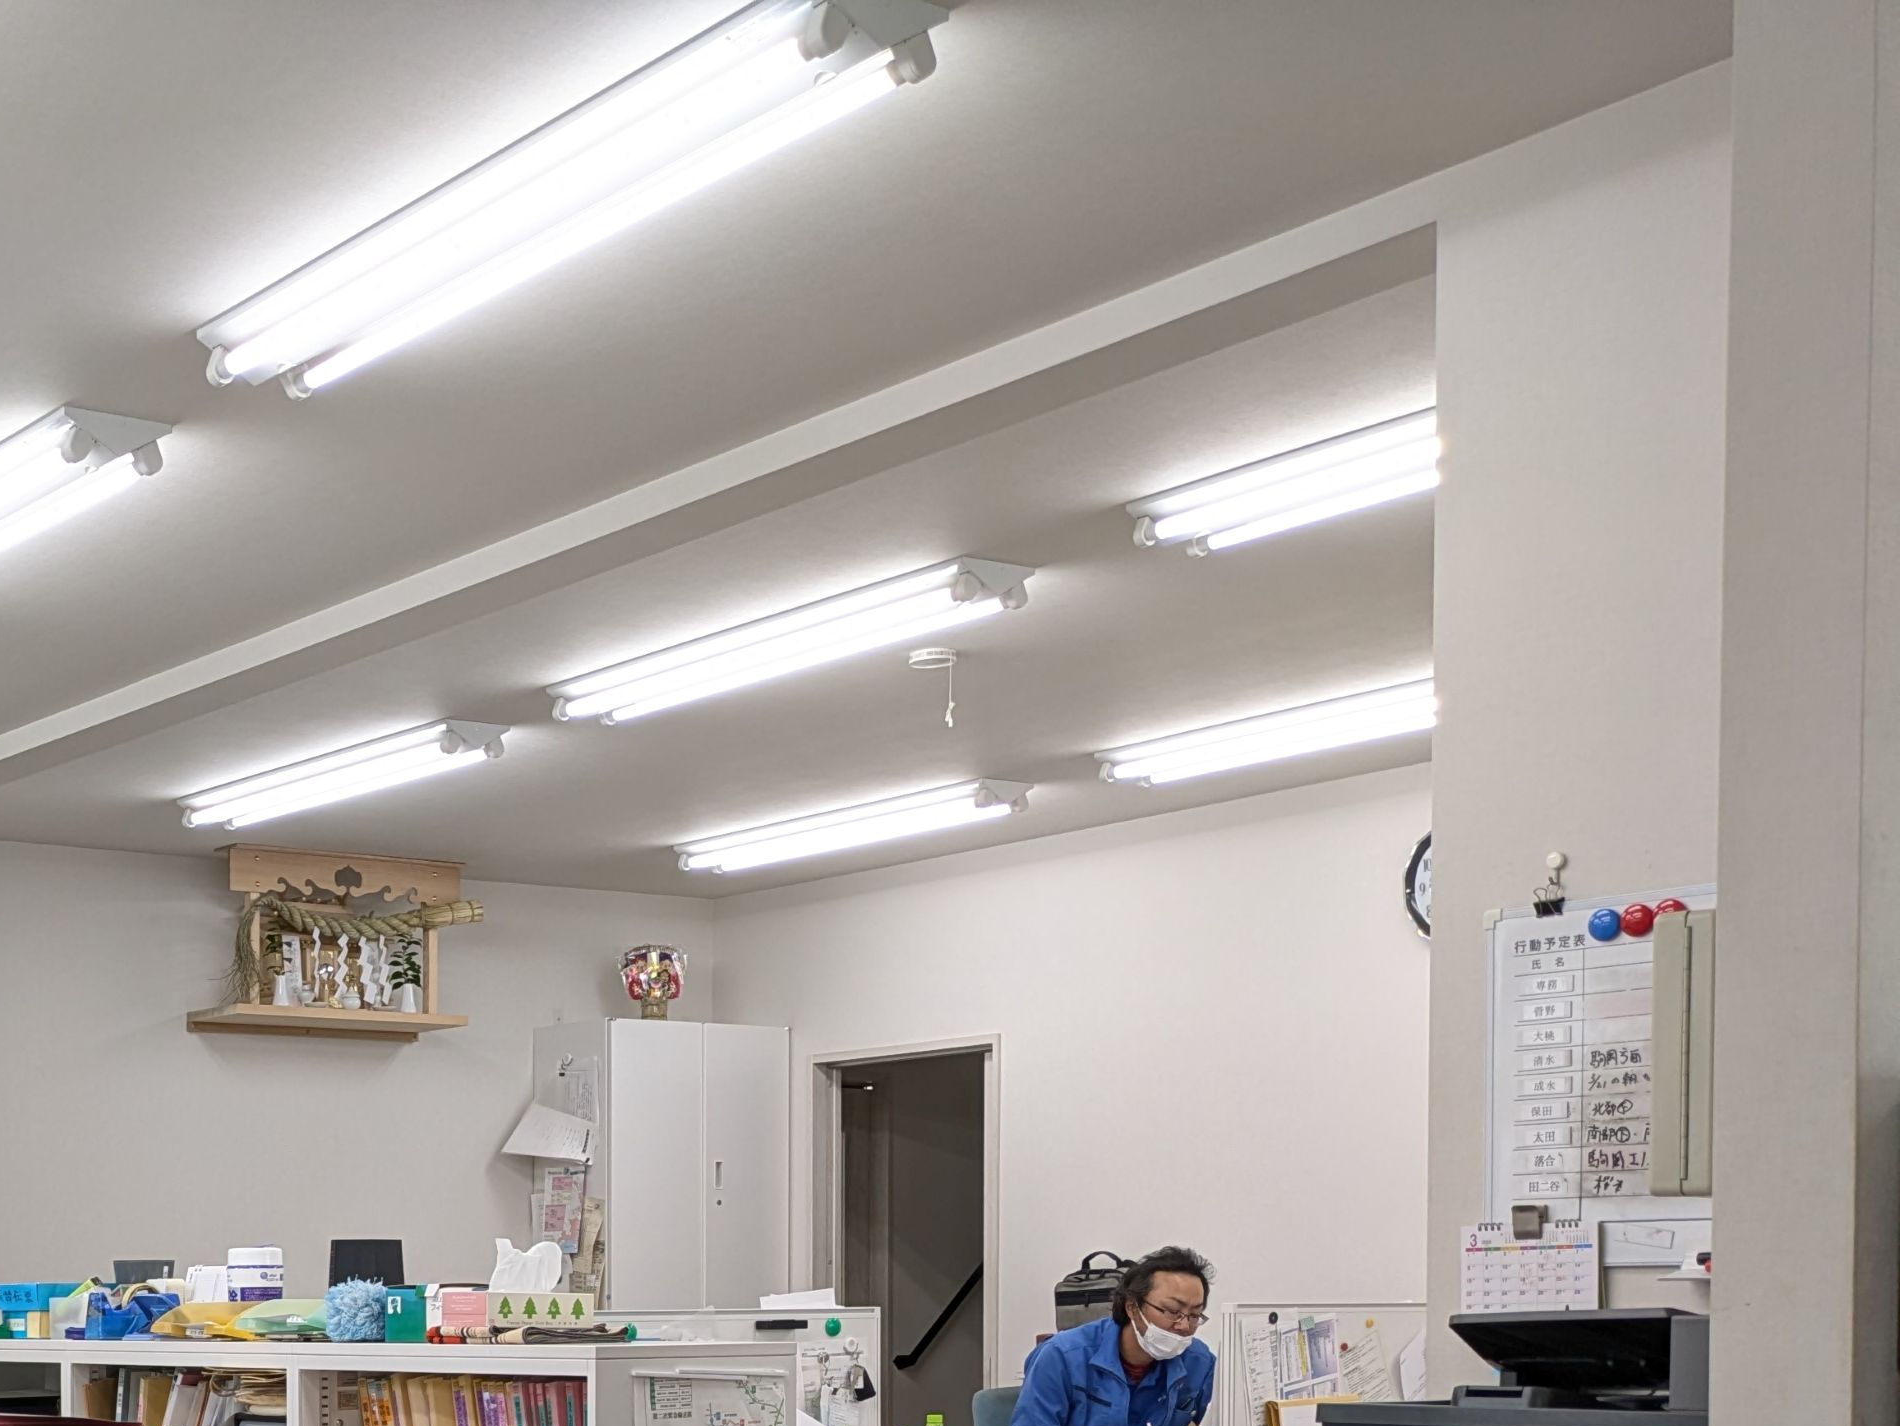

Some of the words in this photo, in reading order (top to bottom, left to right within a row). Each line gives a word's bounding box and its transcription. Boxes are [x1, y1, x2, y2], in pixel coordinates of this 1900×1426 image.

[1419, 882, 1426, 896] 9
[1514, 934, 1585, 954] 行動予定表
[1533, 1131, 1555, 1144] 太田
[1534, 1154, 1555, 1167] 落合
[1470, 1234, 1477, 1247] 3
